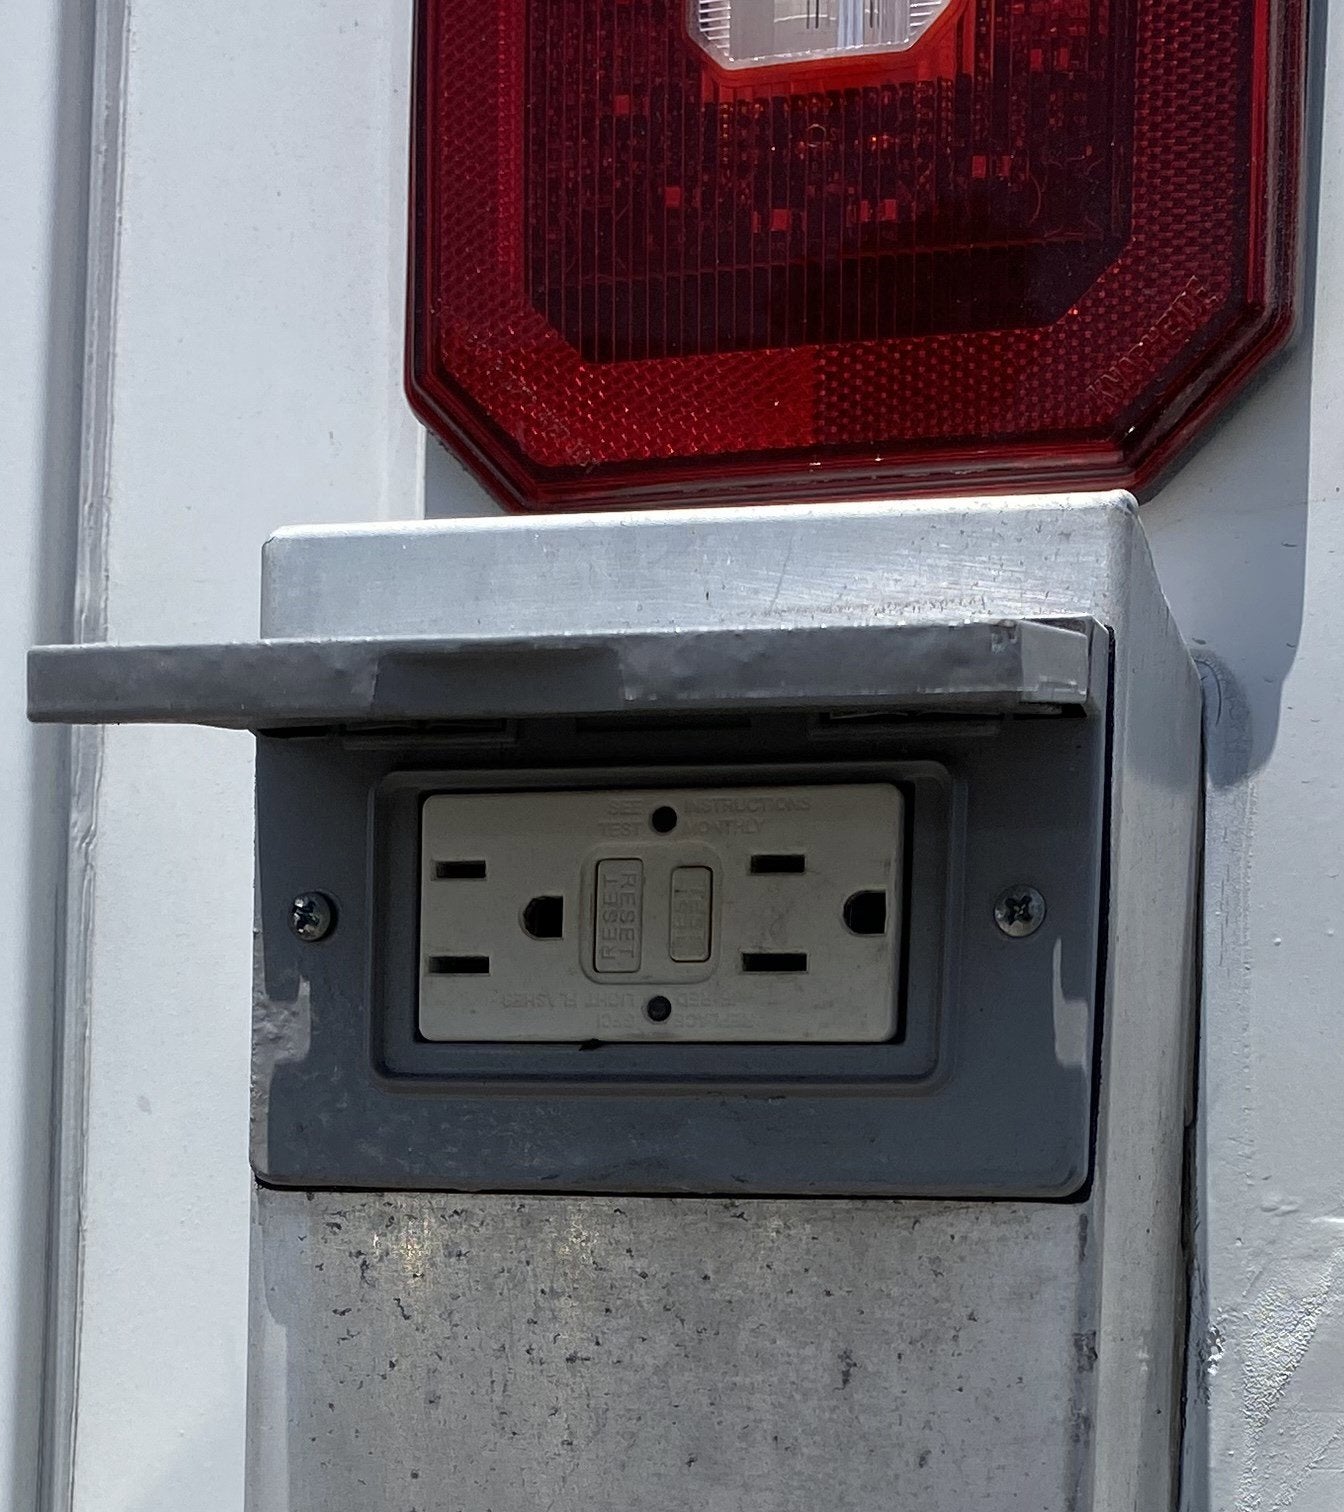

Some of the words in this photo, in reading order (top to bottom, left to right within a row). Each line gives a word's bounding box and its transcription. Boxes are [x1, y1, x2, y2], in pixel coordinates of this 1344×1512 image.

[607, 800, 642, 816] SEE
[684, 797, 811, 814] INSTRUCTIONS
[598, 821, 642, 838] TEST
[682, 818, 766, 836] MONTHLY
[600, 873, 619, 961] RESET
[619, 871, 638, 960] RESET
[499, 992, 577, 1010] FLASHES
[584, 992, 635, 1009] LIGHT
[675, 992, 712, 1009] RED
[673, 1012, 754, 1029] REPLACE
